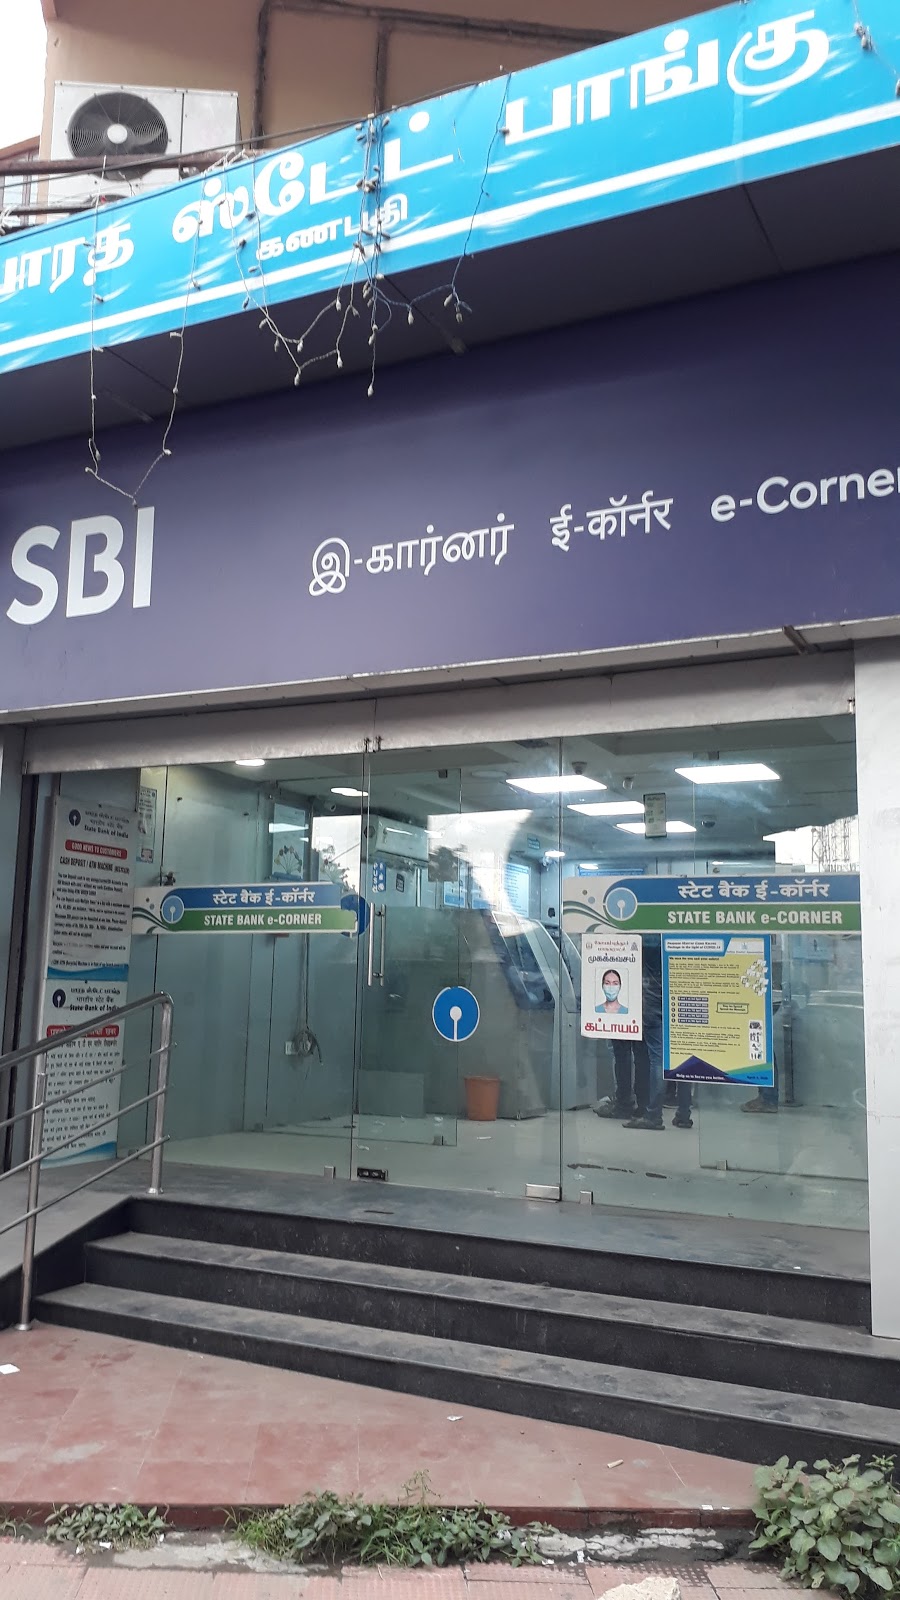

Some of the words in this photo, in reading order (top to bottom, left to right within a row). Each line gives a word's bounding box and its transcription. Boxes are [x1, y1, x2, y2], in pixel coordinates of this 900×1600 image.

[172, 111, 454, 243] ஸ்டேட்
[505, 9, 829, 146] பாங்கு
[256, 193, 408, 261] கணபதி
[549, 490, 674, 552] ई-कॉर्नर
[710, 466, 900, 522] e-Corne
[6, 506, 155, 625] SBI
[308, 512, 515, 597] இ-கார்னர்
[212, 890, 238, 905] स्टेट
[240, 889, 262, 904] बैंक
[667, 911, 710, 924] STATE
[715, 910, 756, 924] BANK
[760, 910, 843, 925] e-CORNER
[677, 881, 714, 899] स्टेट
[718, 880, 750, 898] बैंक
[204, 914, 234, 926] STATE
[237, 914, 265, 926] BANK
[267, 913, 322, 925] e-CORNER
[584, 1017, 639, 1034] கட்டாயம்
